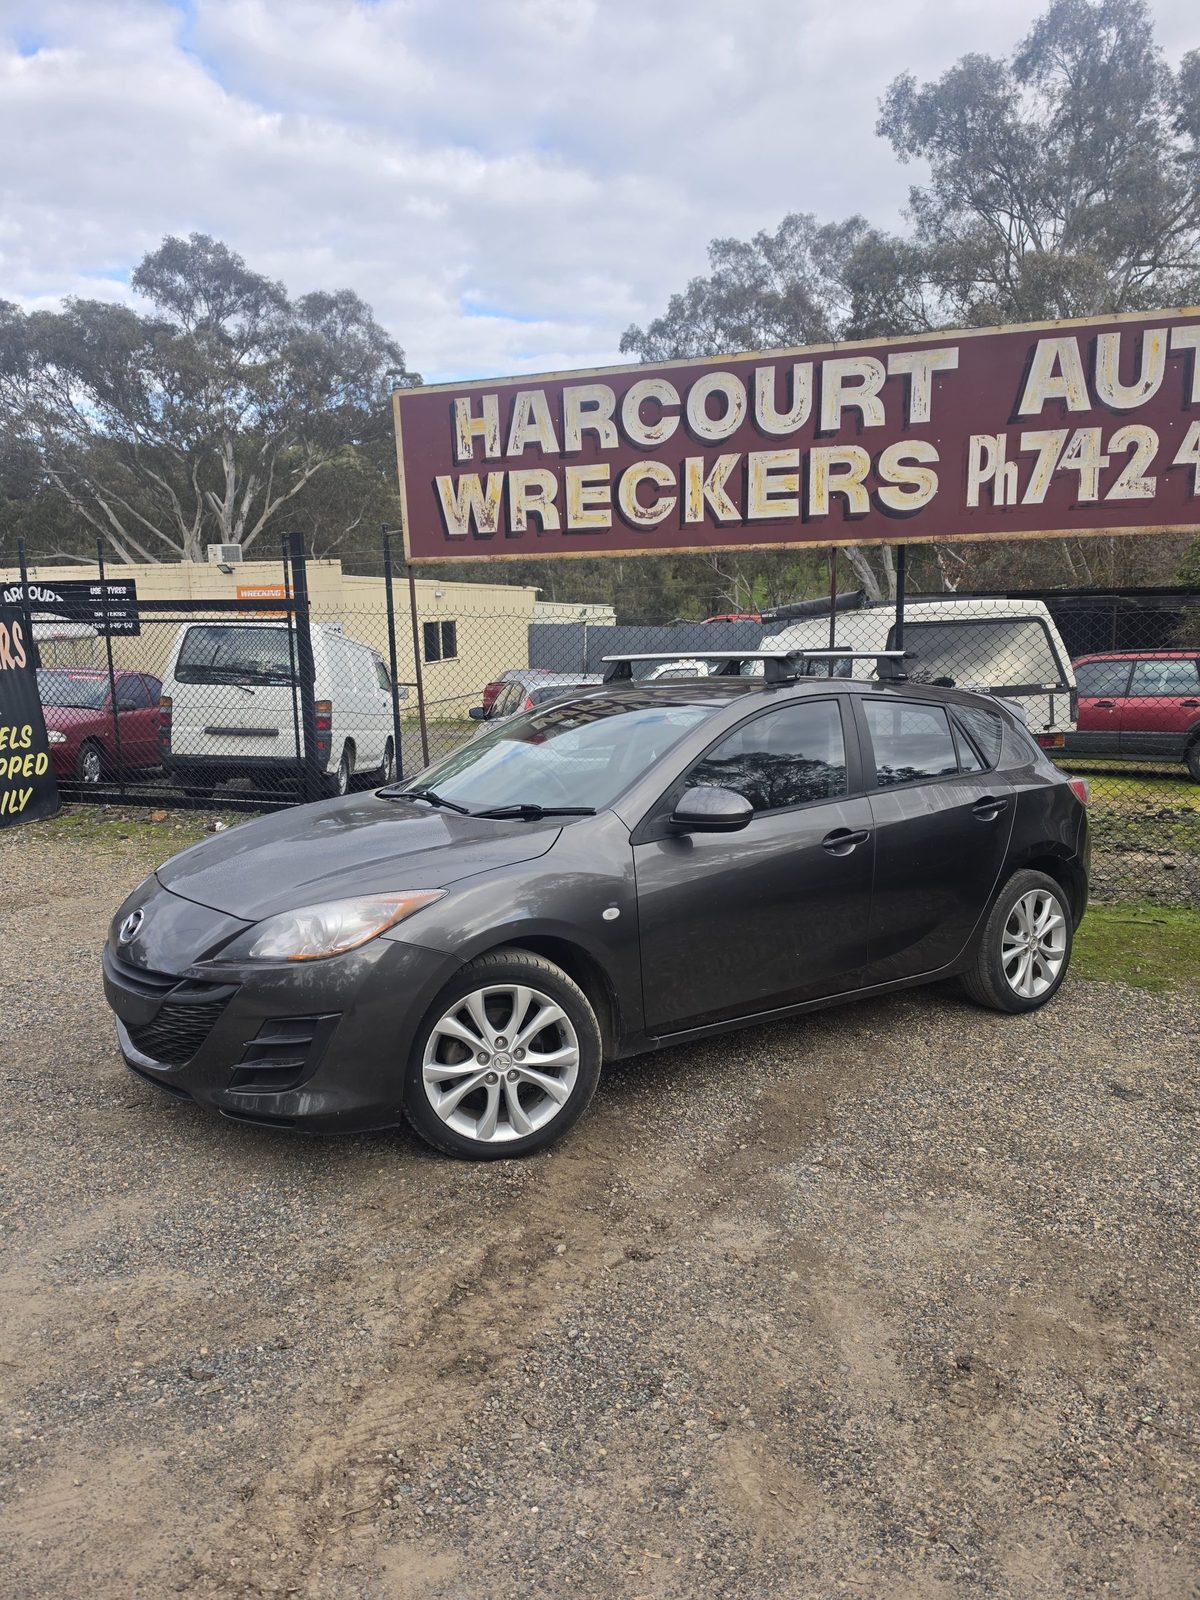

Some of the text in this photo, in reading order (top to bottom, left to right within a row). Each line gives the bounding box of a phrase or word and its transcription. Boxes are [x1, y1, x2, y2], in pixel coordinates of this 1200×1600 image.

[454, 347, 959, 460] HARCOURT
[435, 440, 940, 535] WRECKERS
[90, 587, 102, 595] USE
